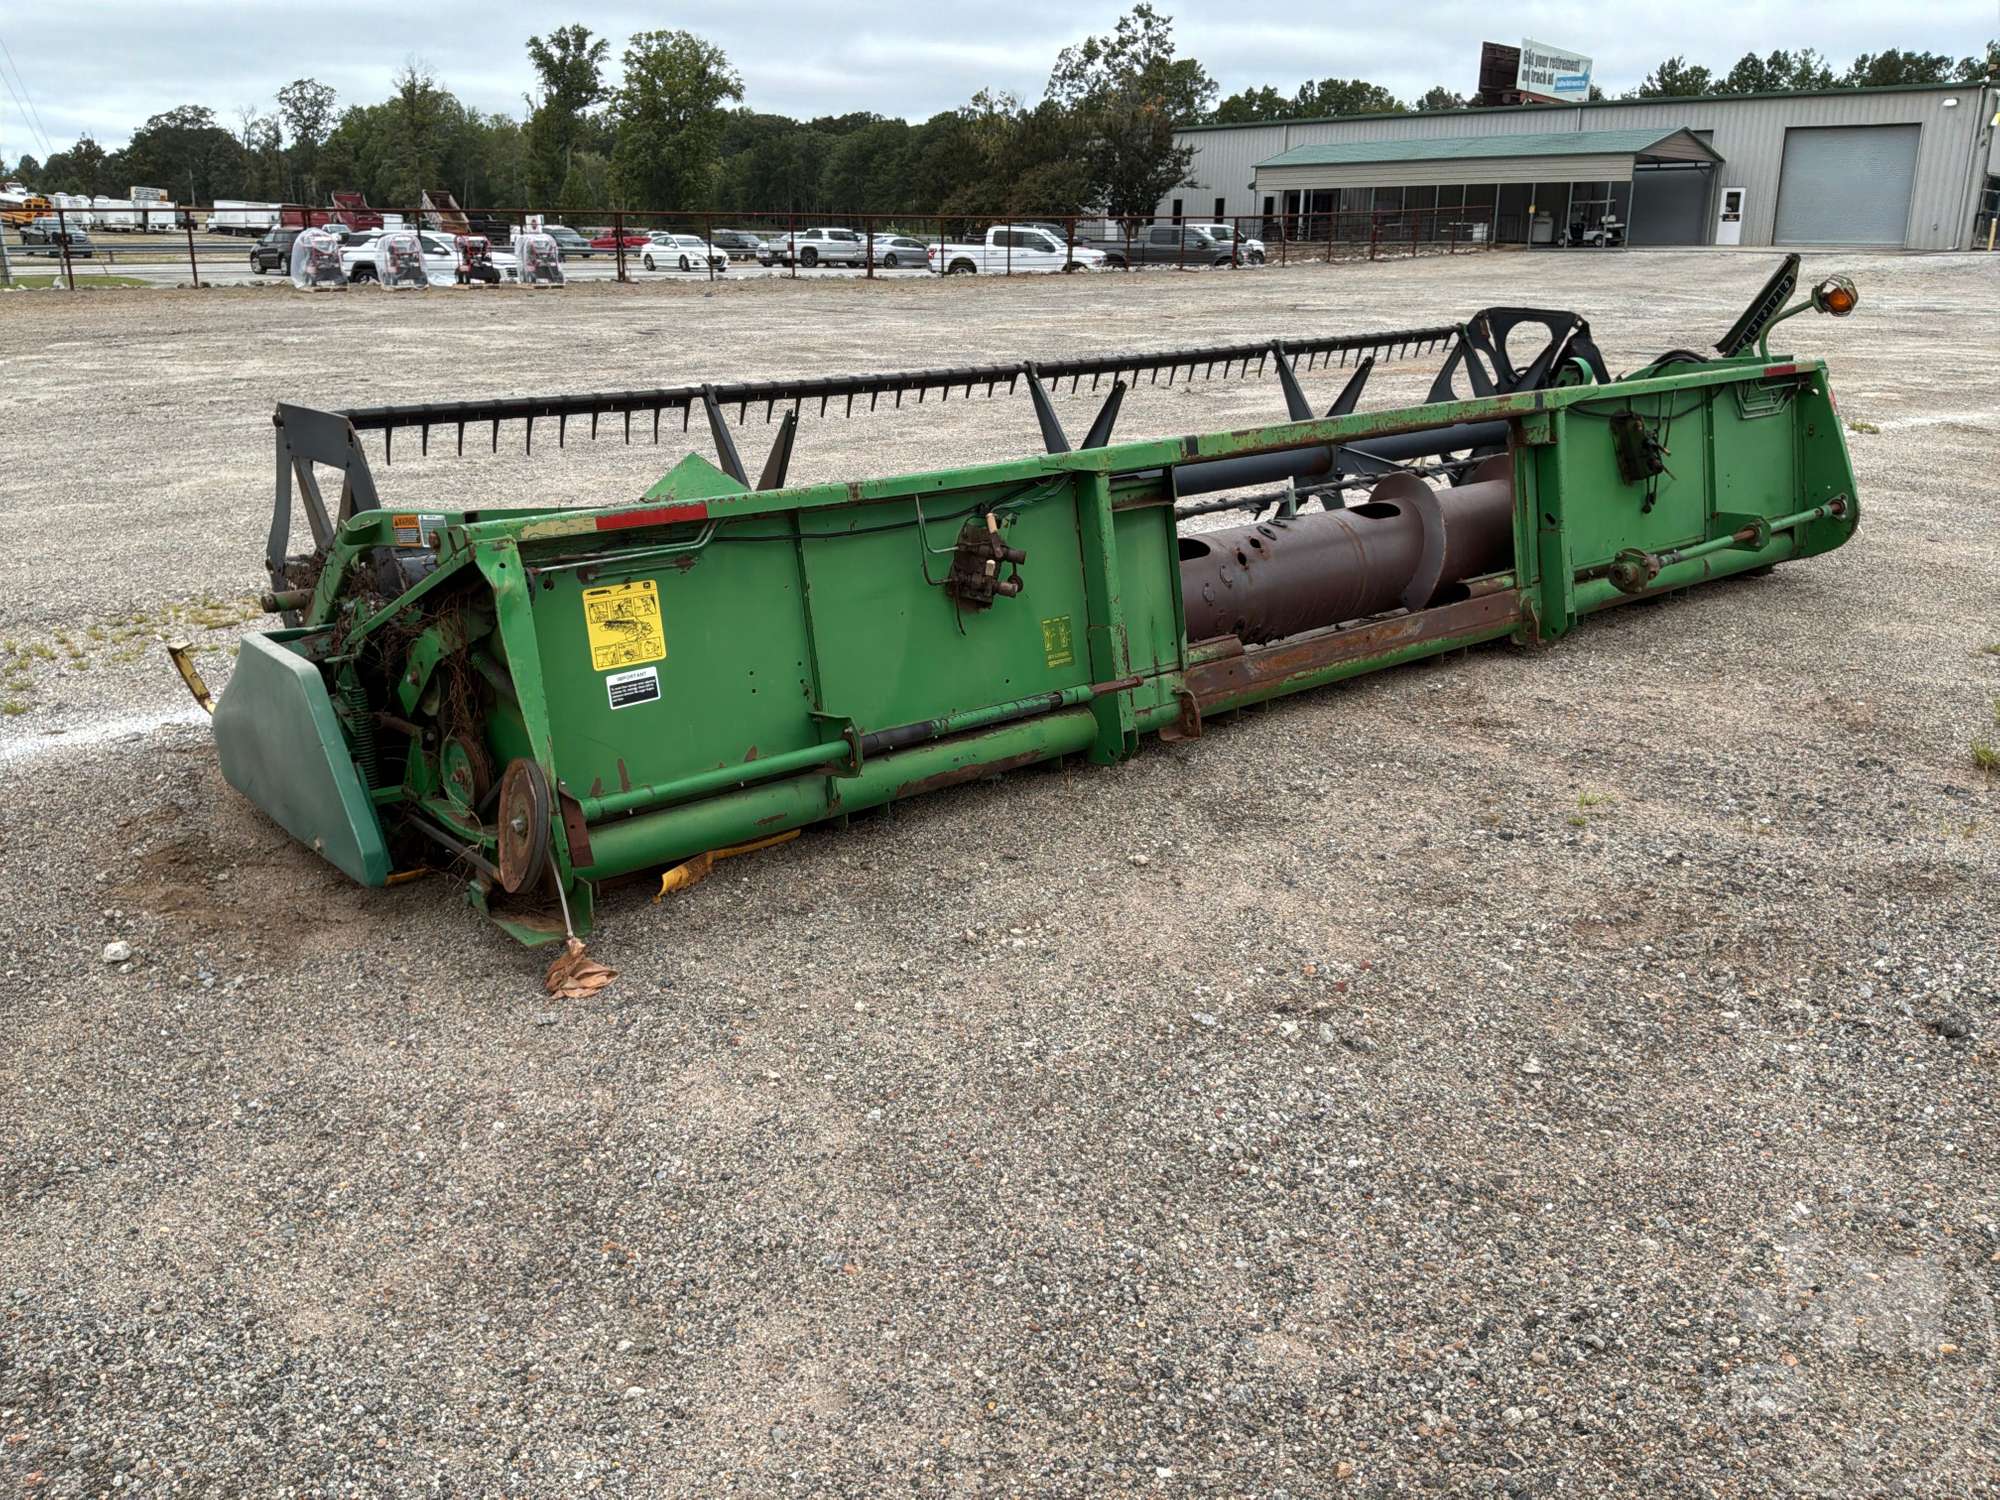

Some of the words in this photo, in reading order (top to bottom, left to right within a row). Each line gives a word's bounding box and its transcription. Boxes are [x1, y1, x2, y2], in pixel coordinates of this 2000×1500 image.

[1535, 55, 1549, 69] your
[1549, 56, 1580, 72] retirement
[1531, 69, 1547, 85] track
